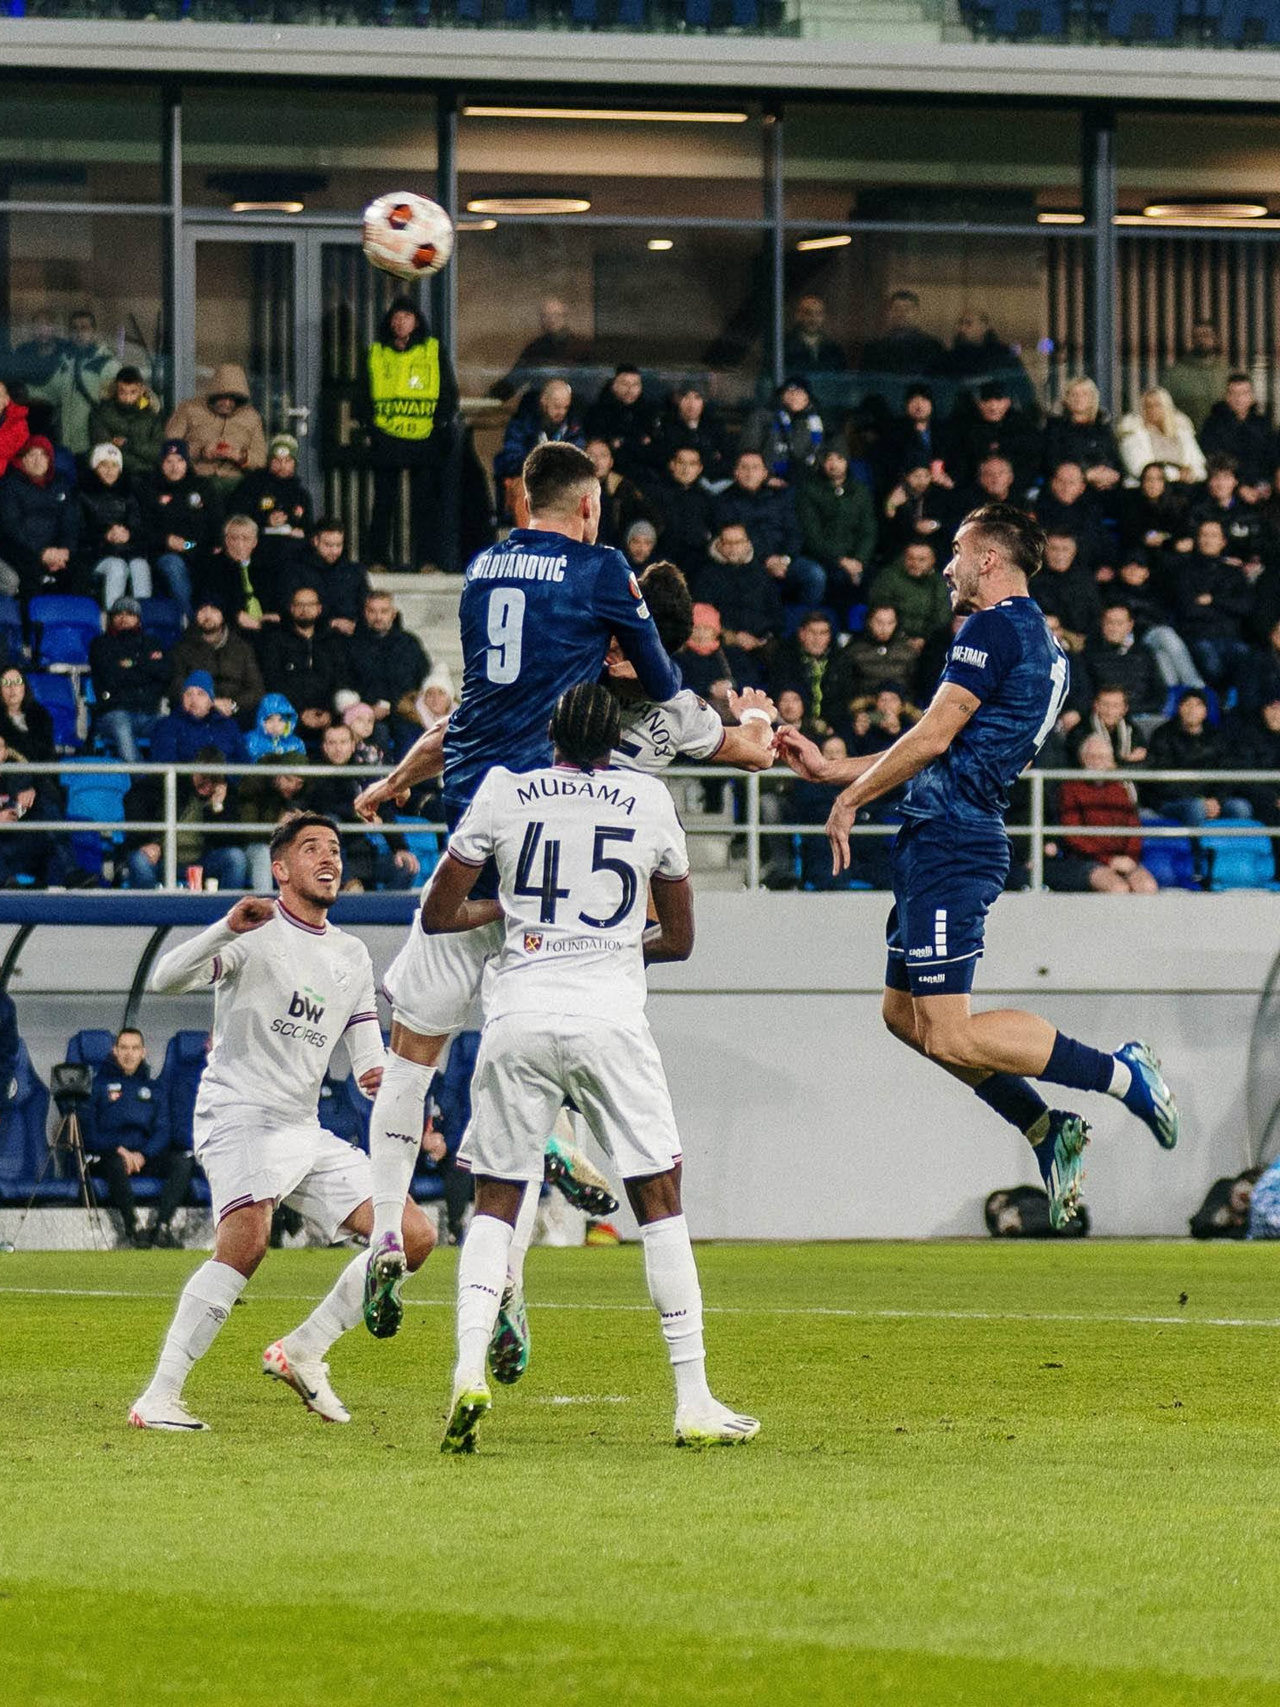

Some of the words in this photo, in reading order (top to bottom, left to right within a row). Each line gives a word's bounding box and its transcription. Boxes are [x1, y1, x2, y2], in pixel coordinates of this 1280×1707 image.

[486, 587, 526, 684] 9
[517, 778, 636, 815] MUBAMA
[514, 821, 637, 929] 45
[546, 937, 623, 953] FOUNDATION
[288, 990, 325, 1025] bw
[270, 1018, 328, 1048] SCORES
